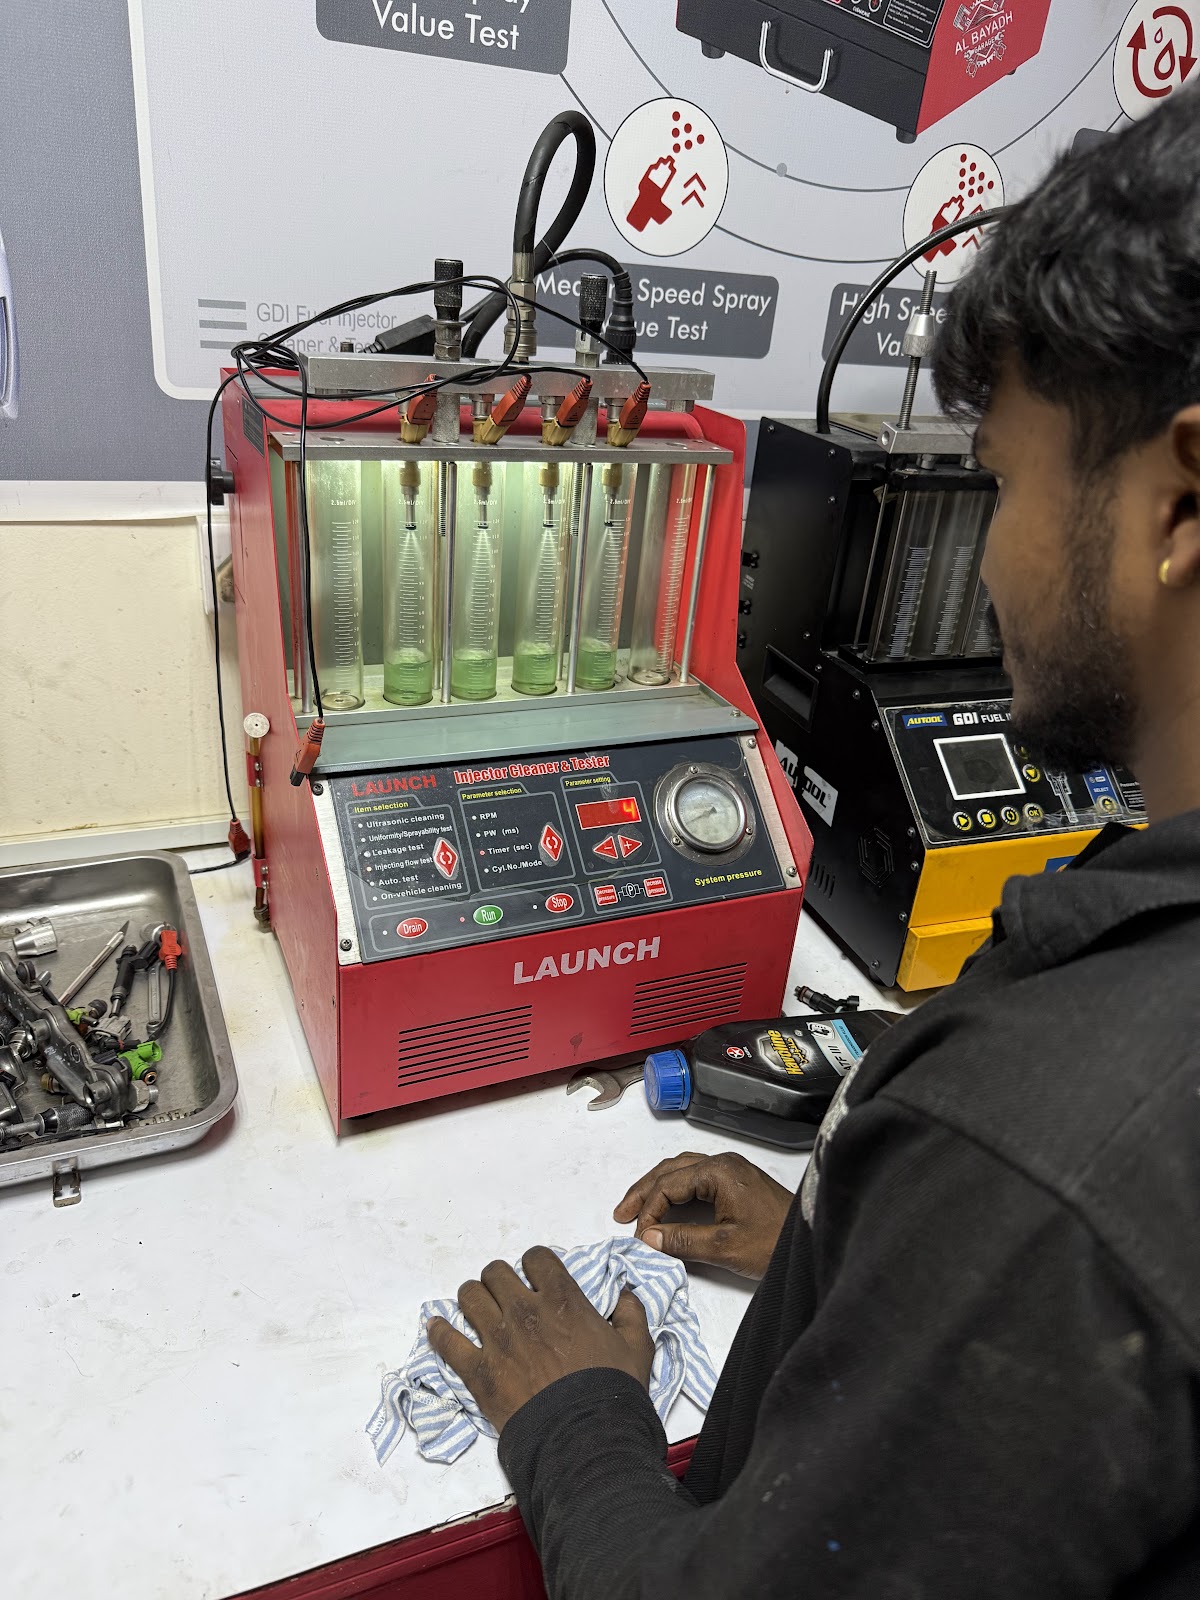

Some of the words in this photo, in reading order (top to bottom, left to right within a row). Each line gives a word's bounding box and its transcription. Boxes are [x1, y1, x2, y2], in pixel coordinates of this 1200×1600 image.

[372, 0, 455, 40] Value
[465, 13, 520, 51] Test
[955, 38, 970, 55] AL
[971, 10, 1013, 45] BAYADH
[637, 278, 702, 309] Speed
[712, 285, 772, 317] Spray
[256, 302, 290, 323] GDI
[840, 292, 891, 325] Hgh
[668, 315, 709, 342] Test
[907, 715, 943, 727] AUTOOL
[952, 711, 979, 726] GDI
[980, 714, 1006, 724] FUEL
[454, 766, 508, 785] Injector
[508, 762, 559, 778] Cleaner
[560, 761, 572, 773] &
[571, 756, 610, 771] Tester
[351, 774, 437, 797] LAUNCH
[565, 778, 592, 787] Parameter
[461, 791, 494, 801] Parameter
[494, 788, 522, 797] selection
[354, 805, 372, 814] Item
[373, 801, 409, 812] selection
[623, 801, 635, 819] 4
[1028, 809, 1040, 817] OK
[366, 817, 410, 829] Ultrasonic
[410, 813, 445, 824] cleaning
[479, 812, 498, 821] RPM
[440, 825, 453, 833] test
[483, 829, 497, 838] PW
[502, 826, 520, 837] (ms)
[371, 846, 407, 857] Leakage
[408, 843, 425, 852] test
[487, 846, 510, 856] Timer
[513, 842, 533, 853] (sec)
[374, 861, 405, 872] Injecting
[405, 859, 420, 868] flow
[420, 857, 434, 865] test
[402, 874, 419, 883] test
[694, 874, 726, 888] System
[726, 869, 763, 884] pressure
[380, 887, 426, 901] On-vehicle
[427, 882, 462, 894] cleaning
[551, 896, 568, 911] Stop
[481, 908, 496, 922] Run
[403, 920, 423, 934] Drain
[513, 935, 661, 985] LAUNCH
[767, 1029, 804, 1075] Havoline
